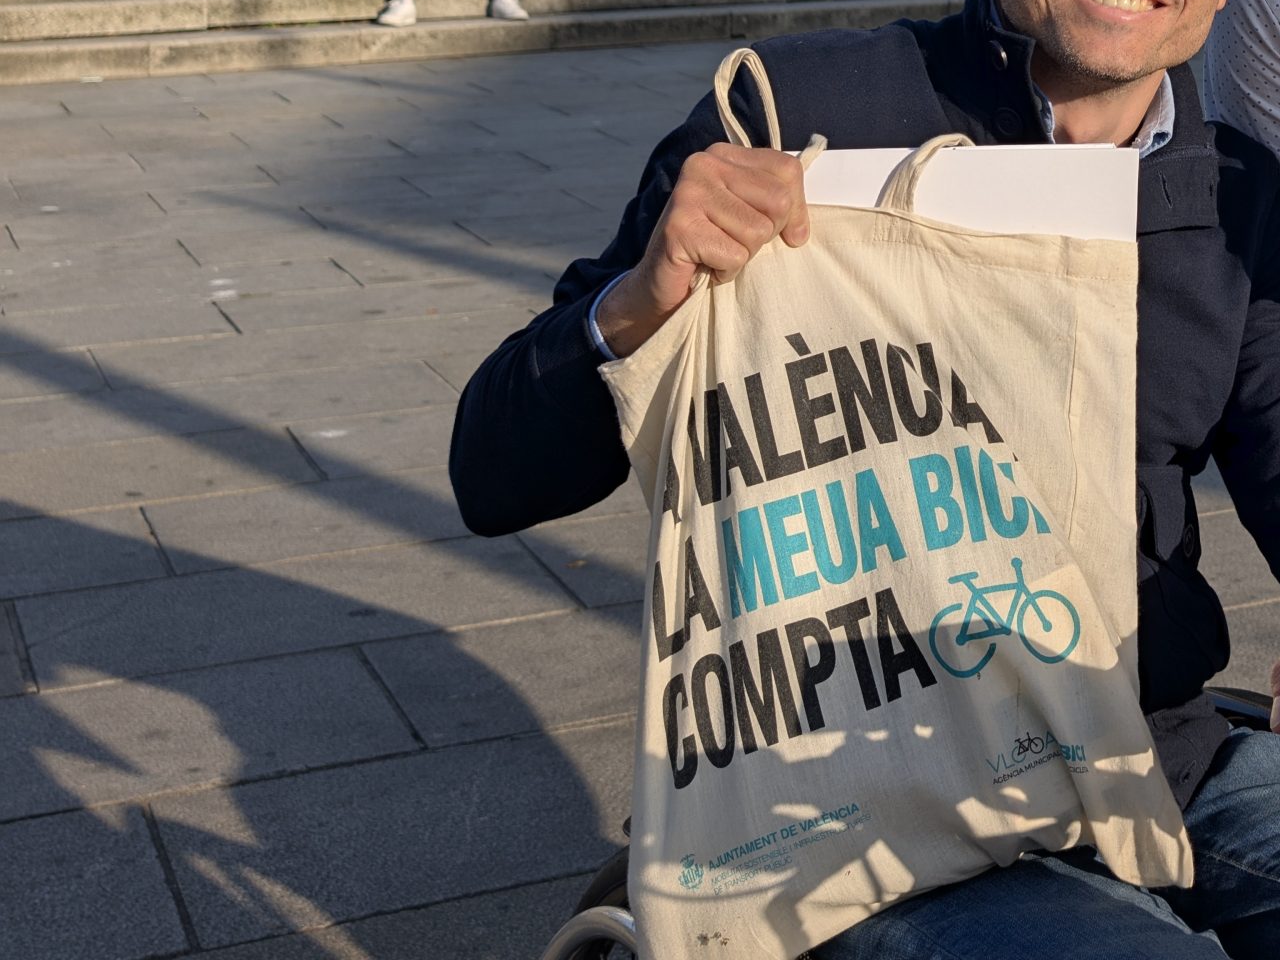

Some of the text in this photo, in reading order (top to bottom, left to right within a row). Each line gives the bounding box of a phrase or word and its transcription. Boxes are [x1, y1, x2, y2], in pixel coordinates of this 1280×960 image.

[652, 535, 722, 663] LA
[721, 467, 907, 620] MEUA
[662, 586, 938, 790] COMPTA
[993, 750, 1062, 786] AGÈNCIA MUNICIPAL
[1059, 744, 1087, 762] BICI
[708, 803, 860, 872] AJUNTAMENT DE VALÈNCIA
[744, 847, 789, 870] SOSTENIBLE
[723, 868, 763, 892] TRANSPORT
